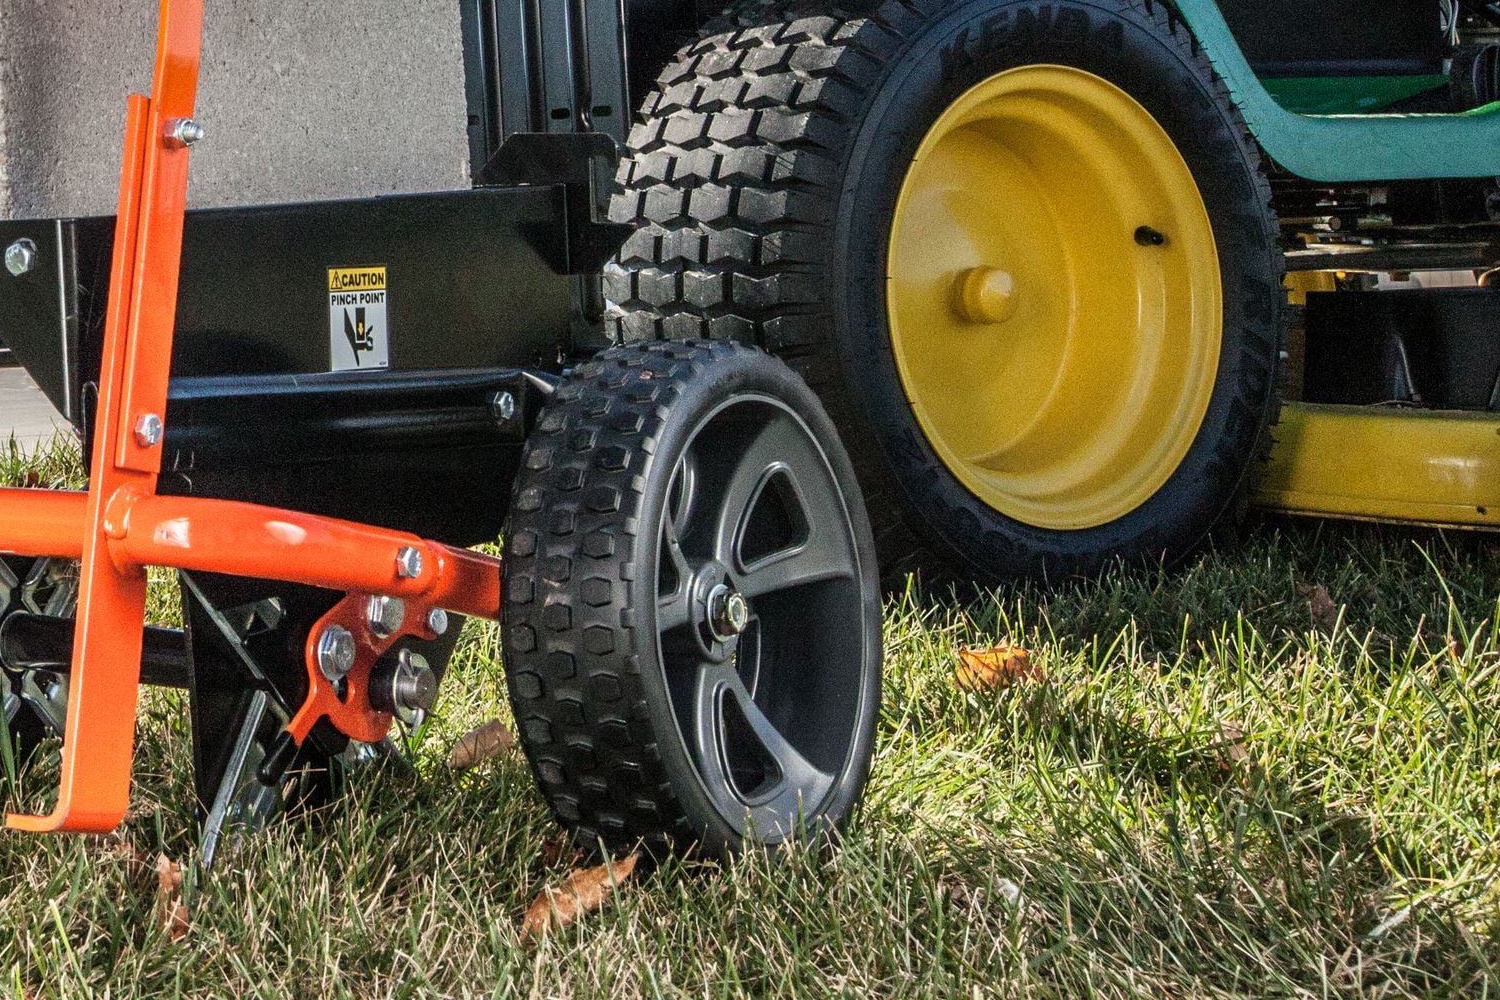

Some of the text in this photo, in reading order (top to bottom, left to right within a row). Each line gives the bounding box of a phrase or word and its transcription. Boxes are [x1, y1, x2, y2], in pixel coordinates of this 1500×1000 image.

[341, 272, 385, 287] CAUTION
[331, 292, 384, 306] PINCH POINT
